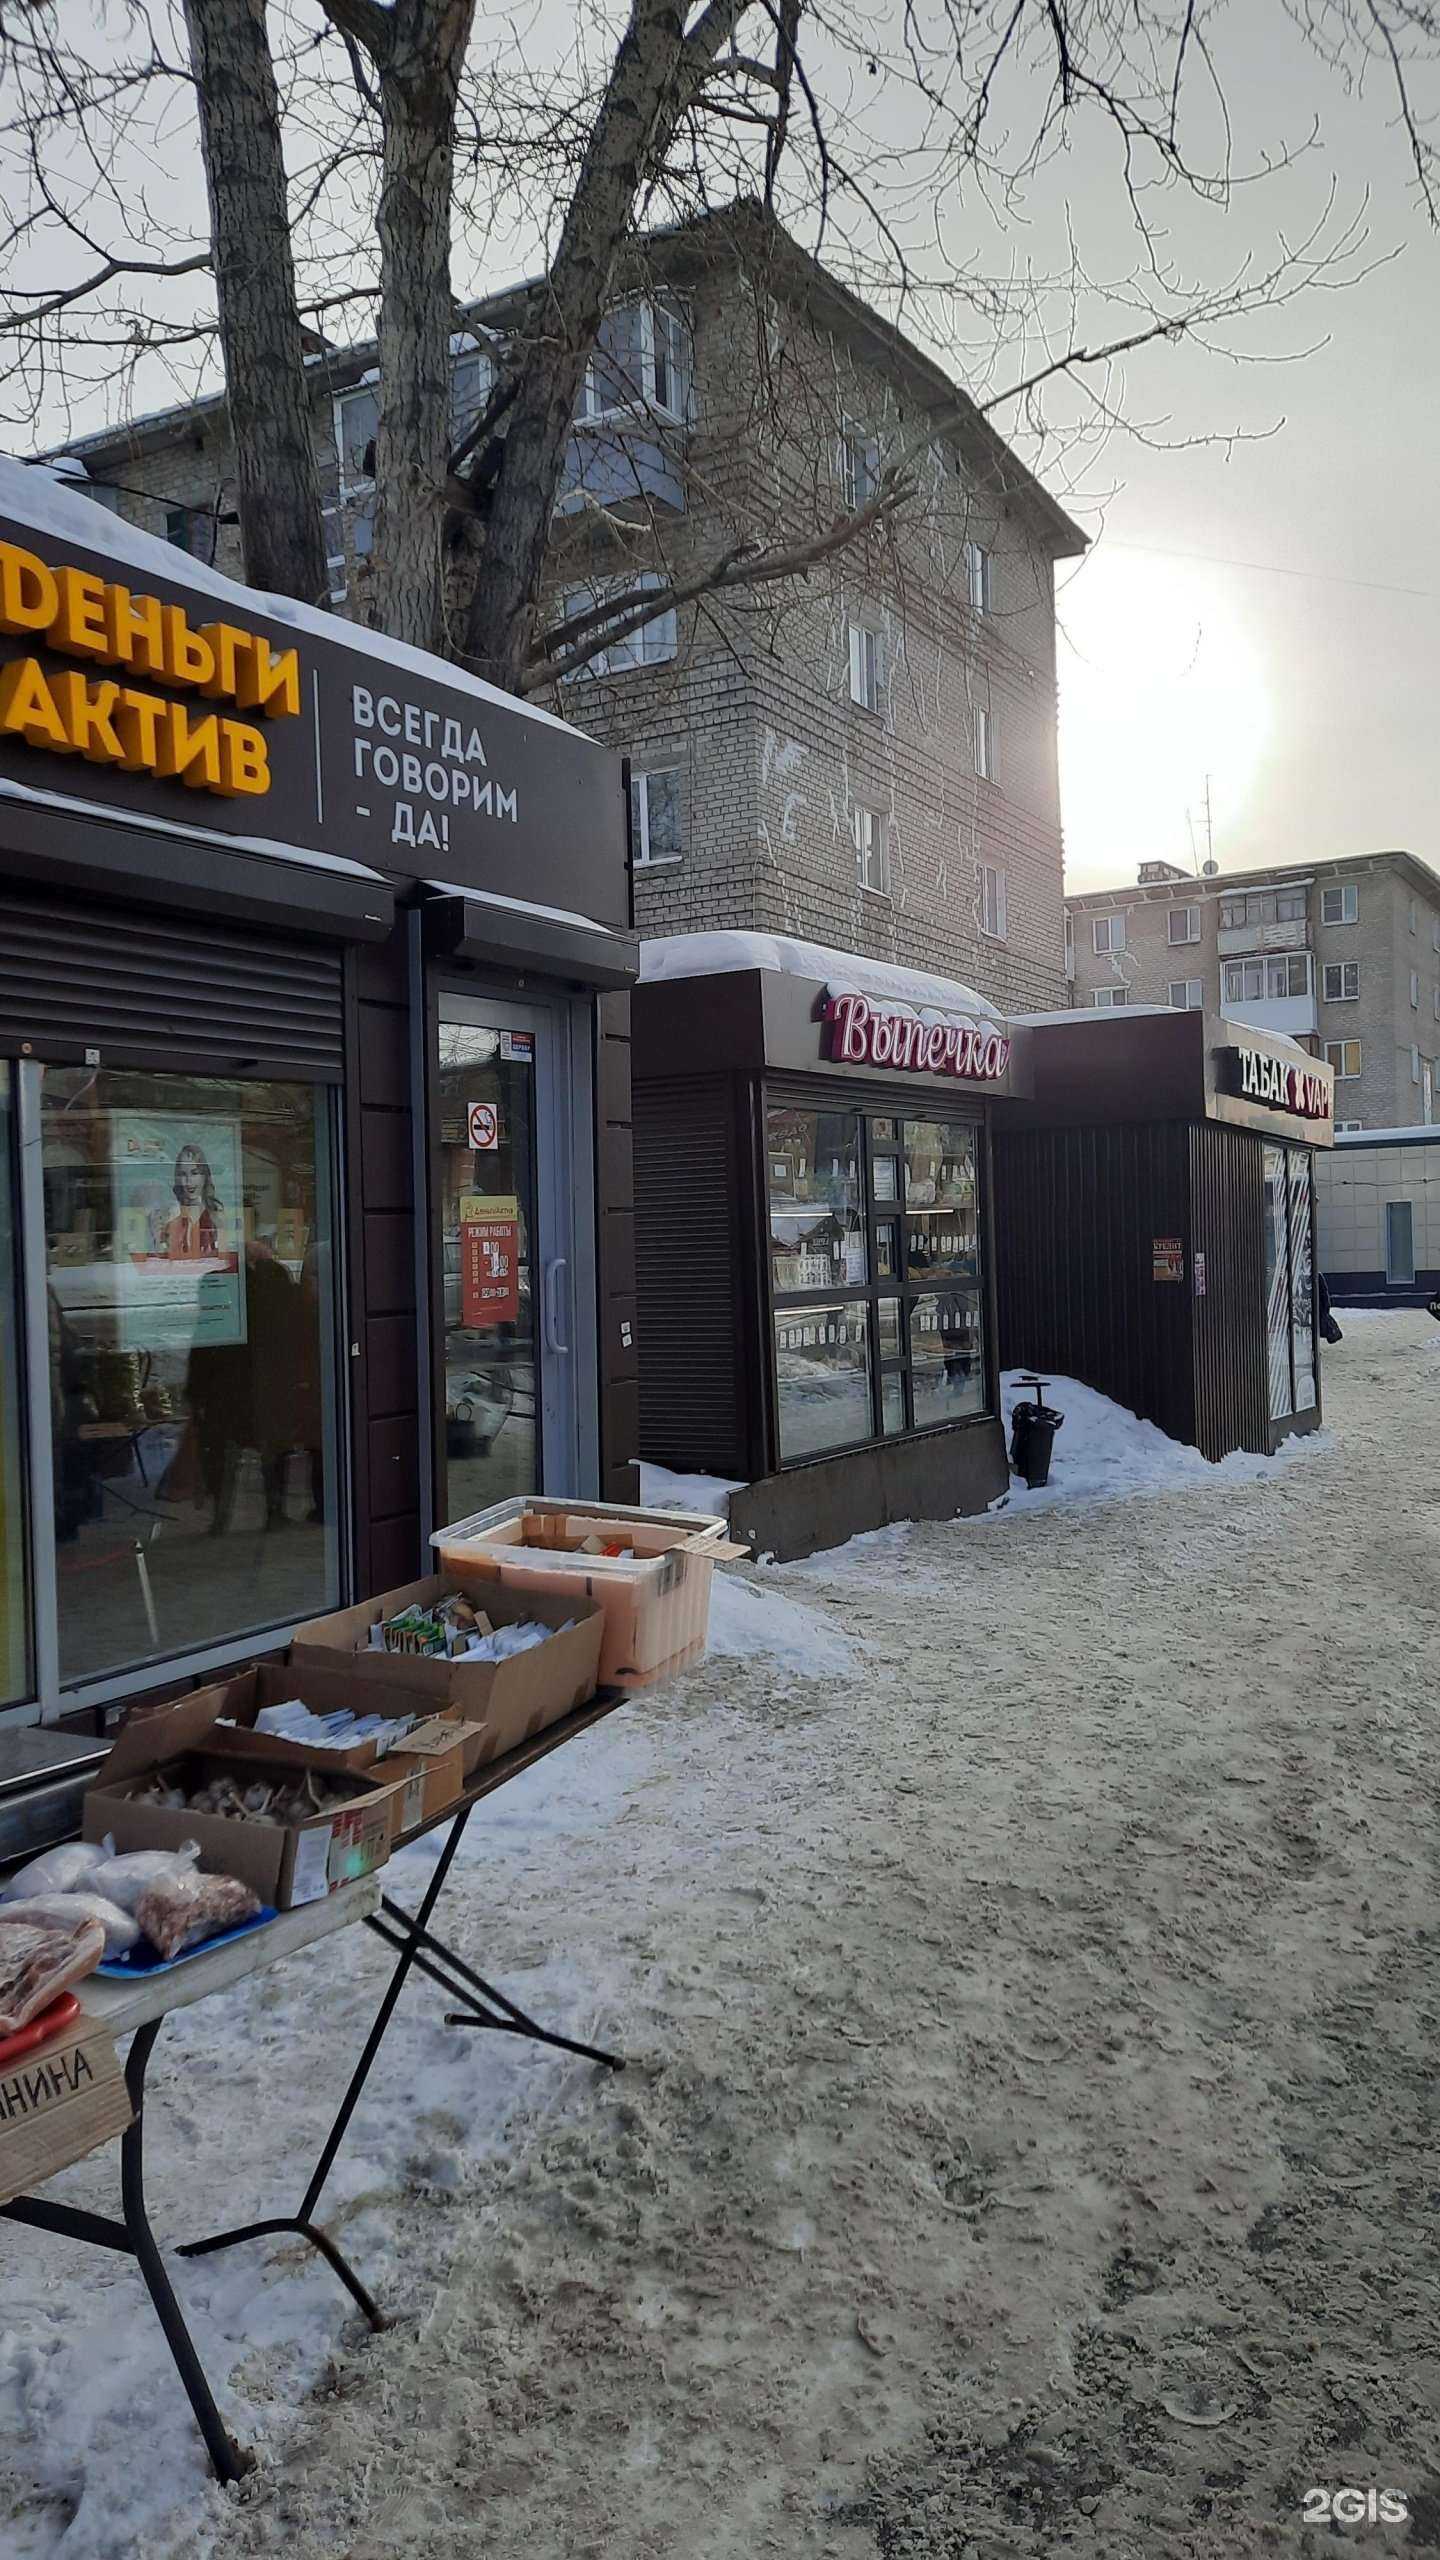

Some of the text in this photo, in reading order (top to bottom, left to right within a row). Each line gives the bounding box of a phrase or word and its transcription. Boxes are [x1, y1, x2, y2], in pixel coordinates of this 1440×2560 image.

[1, 656, 271, 796] АКТИВ
[353, 685, 487, 766] ВСЕГДА
[354, 737, 518, 823] ГОВОРИМ
[391, 801, 449, 851] ДА!
[834, 994, 1010, 1077] Выпечка
[1239, 1047, 1290, 1106] ТАБАК
[0, 2048, 94, 2120] НИНА
